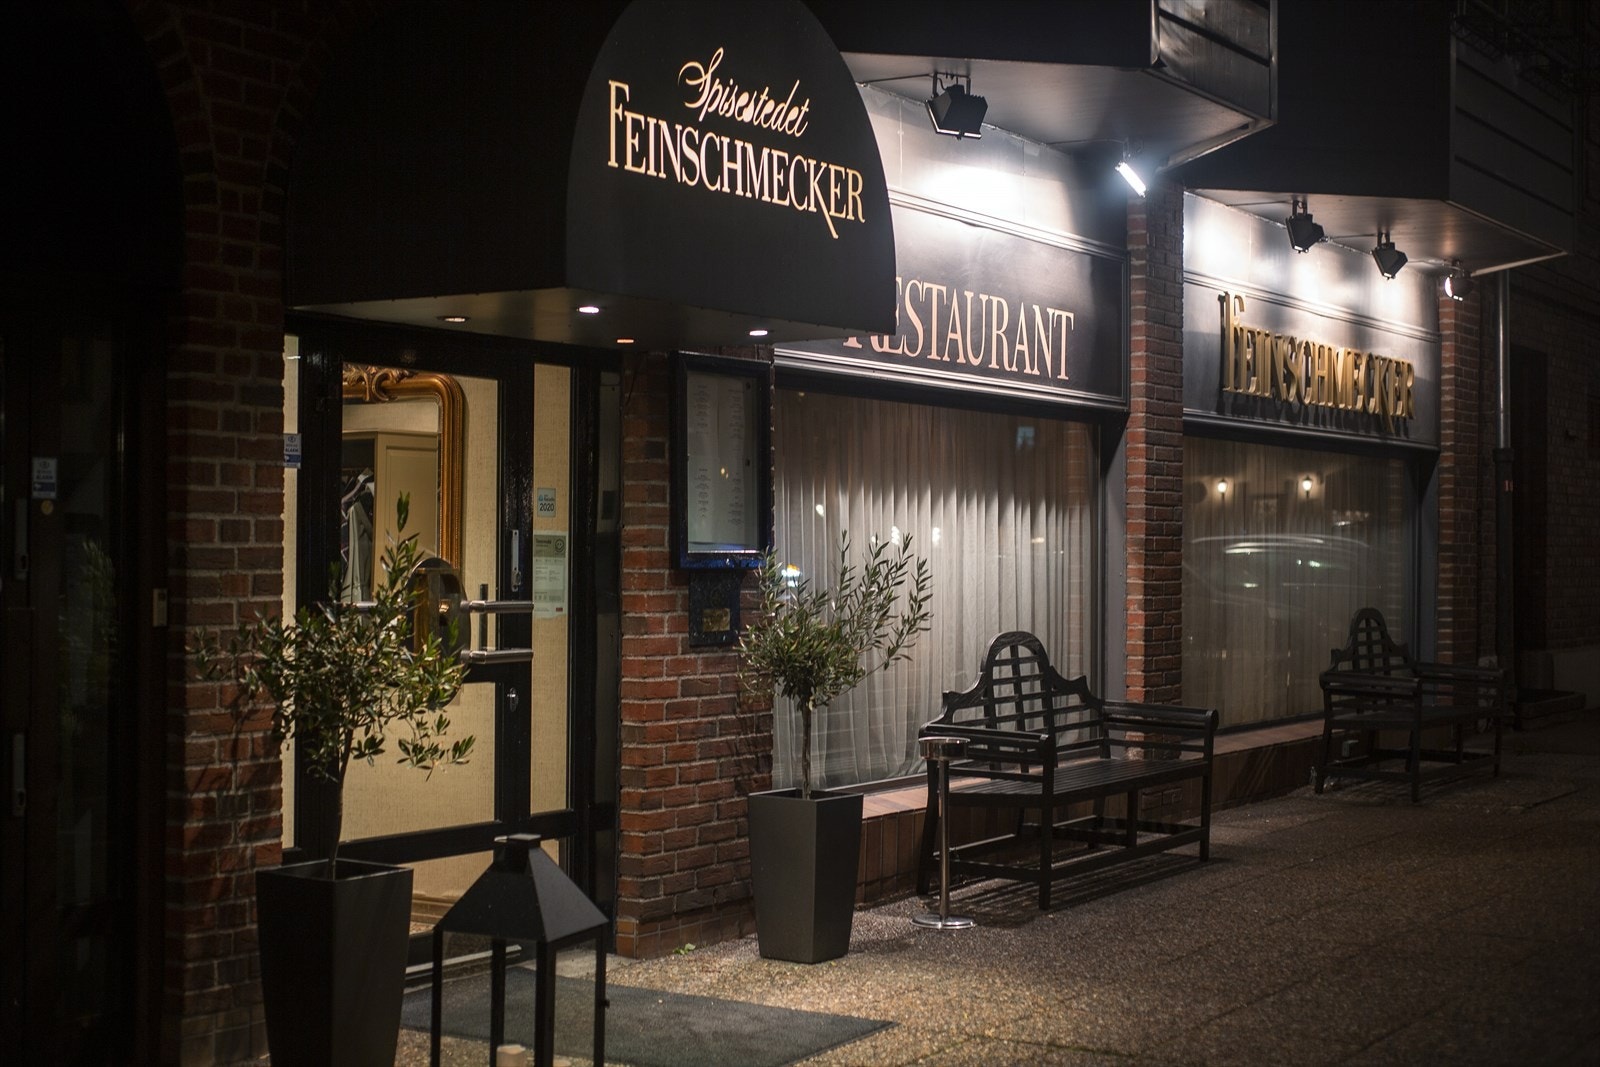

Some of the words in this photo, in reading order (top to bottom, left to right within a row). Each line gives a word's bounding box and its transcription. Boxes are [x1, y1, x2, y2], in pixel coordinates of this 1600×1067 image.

[677, 46, 810, 137] Spisestedet
[607, 79, 865, 239] FEINSCHMECKER
[843, 277, 1074, 381] ESTAURANT
[1222, 291, 1414, 436] FEINSCHMECKER
[539, 502, 555, 512] 2020
